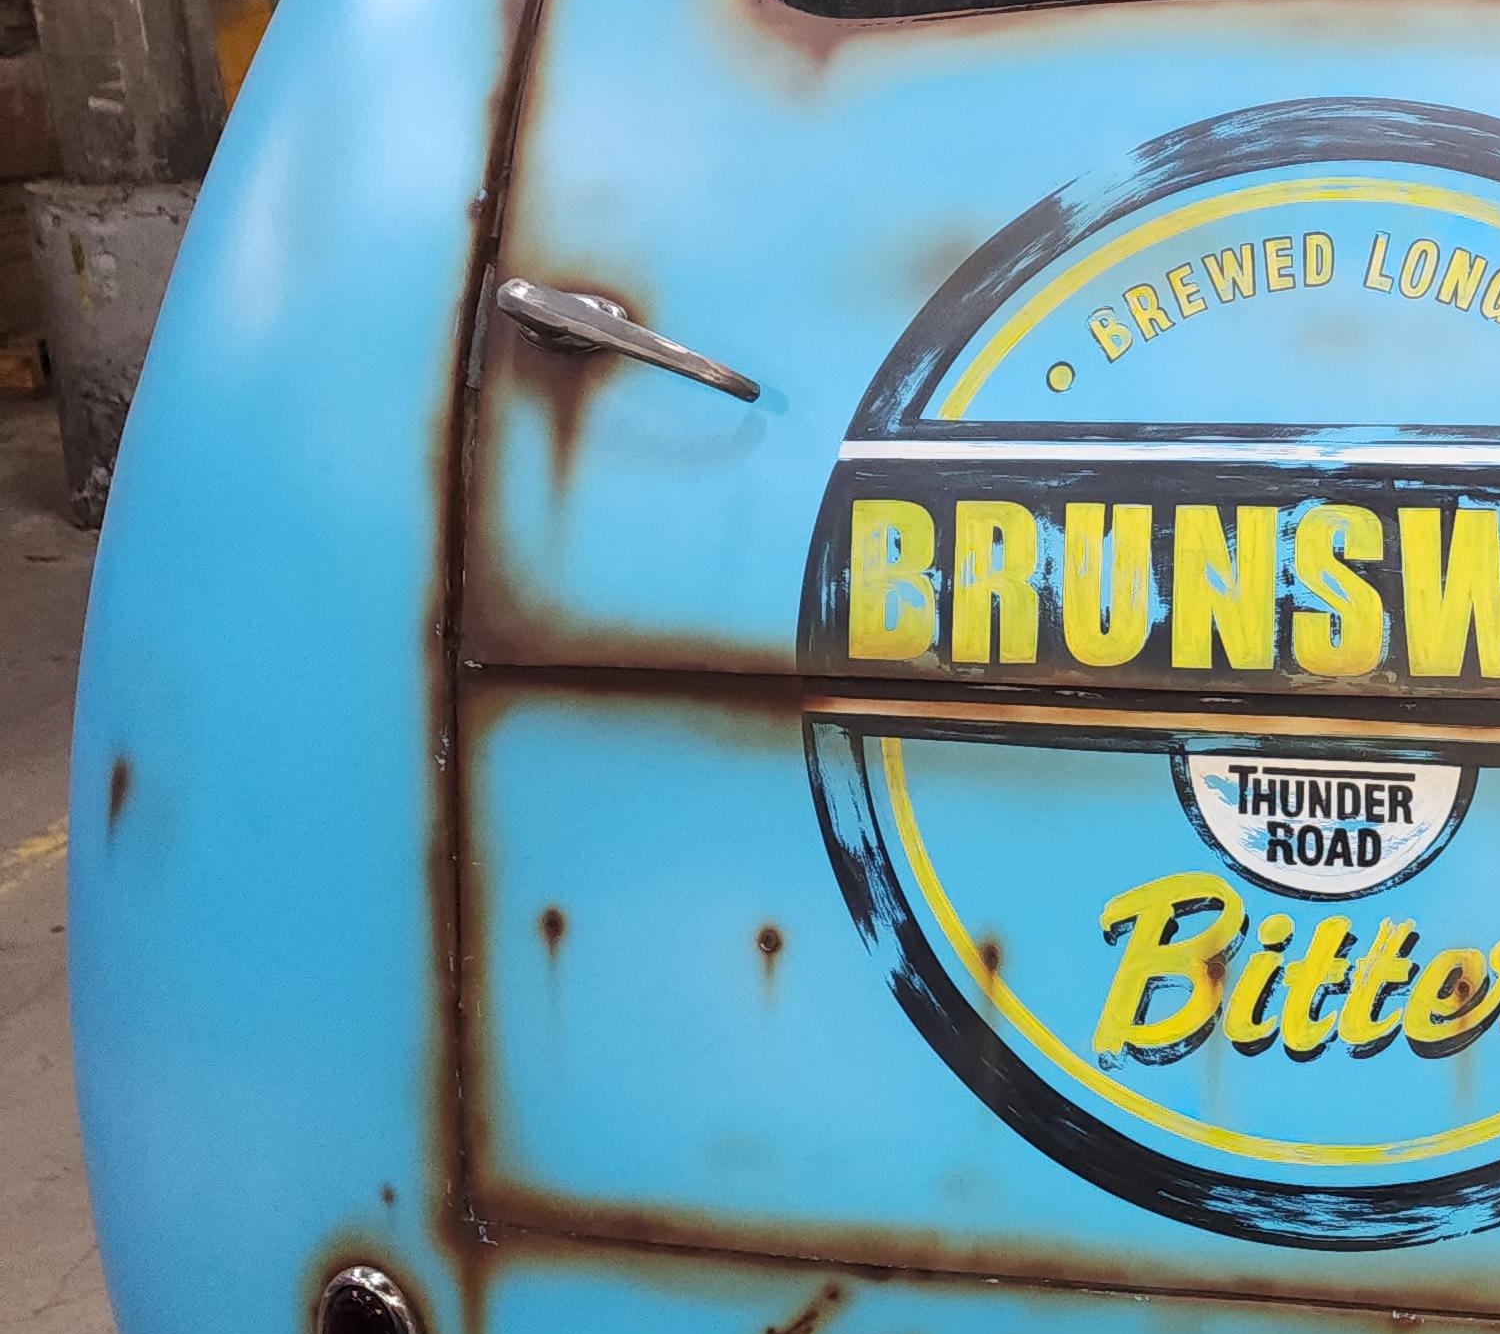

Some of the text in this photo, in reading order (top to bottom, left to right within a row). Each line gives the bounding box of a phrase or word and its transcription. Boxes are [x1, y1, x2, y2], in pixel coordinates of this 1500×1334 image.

[1085, 230, 1335, 364] BREWED
[1228, 764, 1414, 825] THUNDER
[1266, 821, 1383, 868] ROAD
